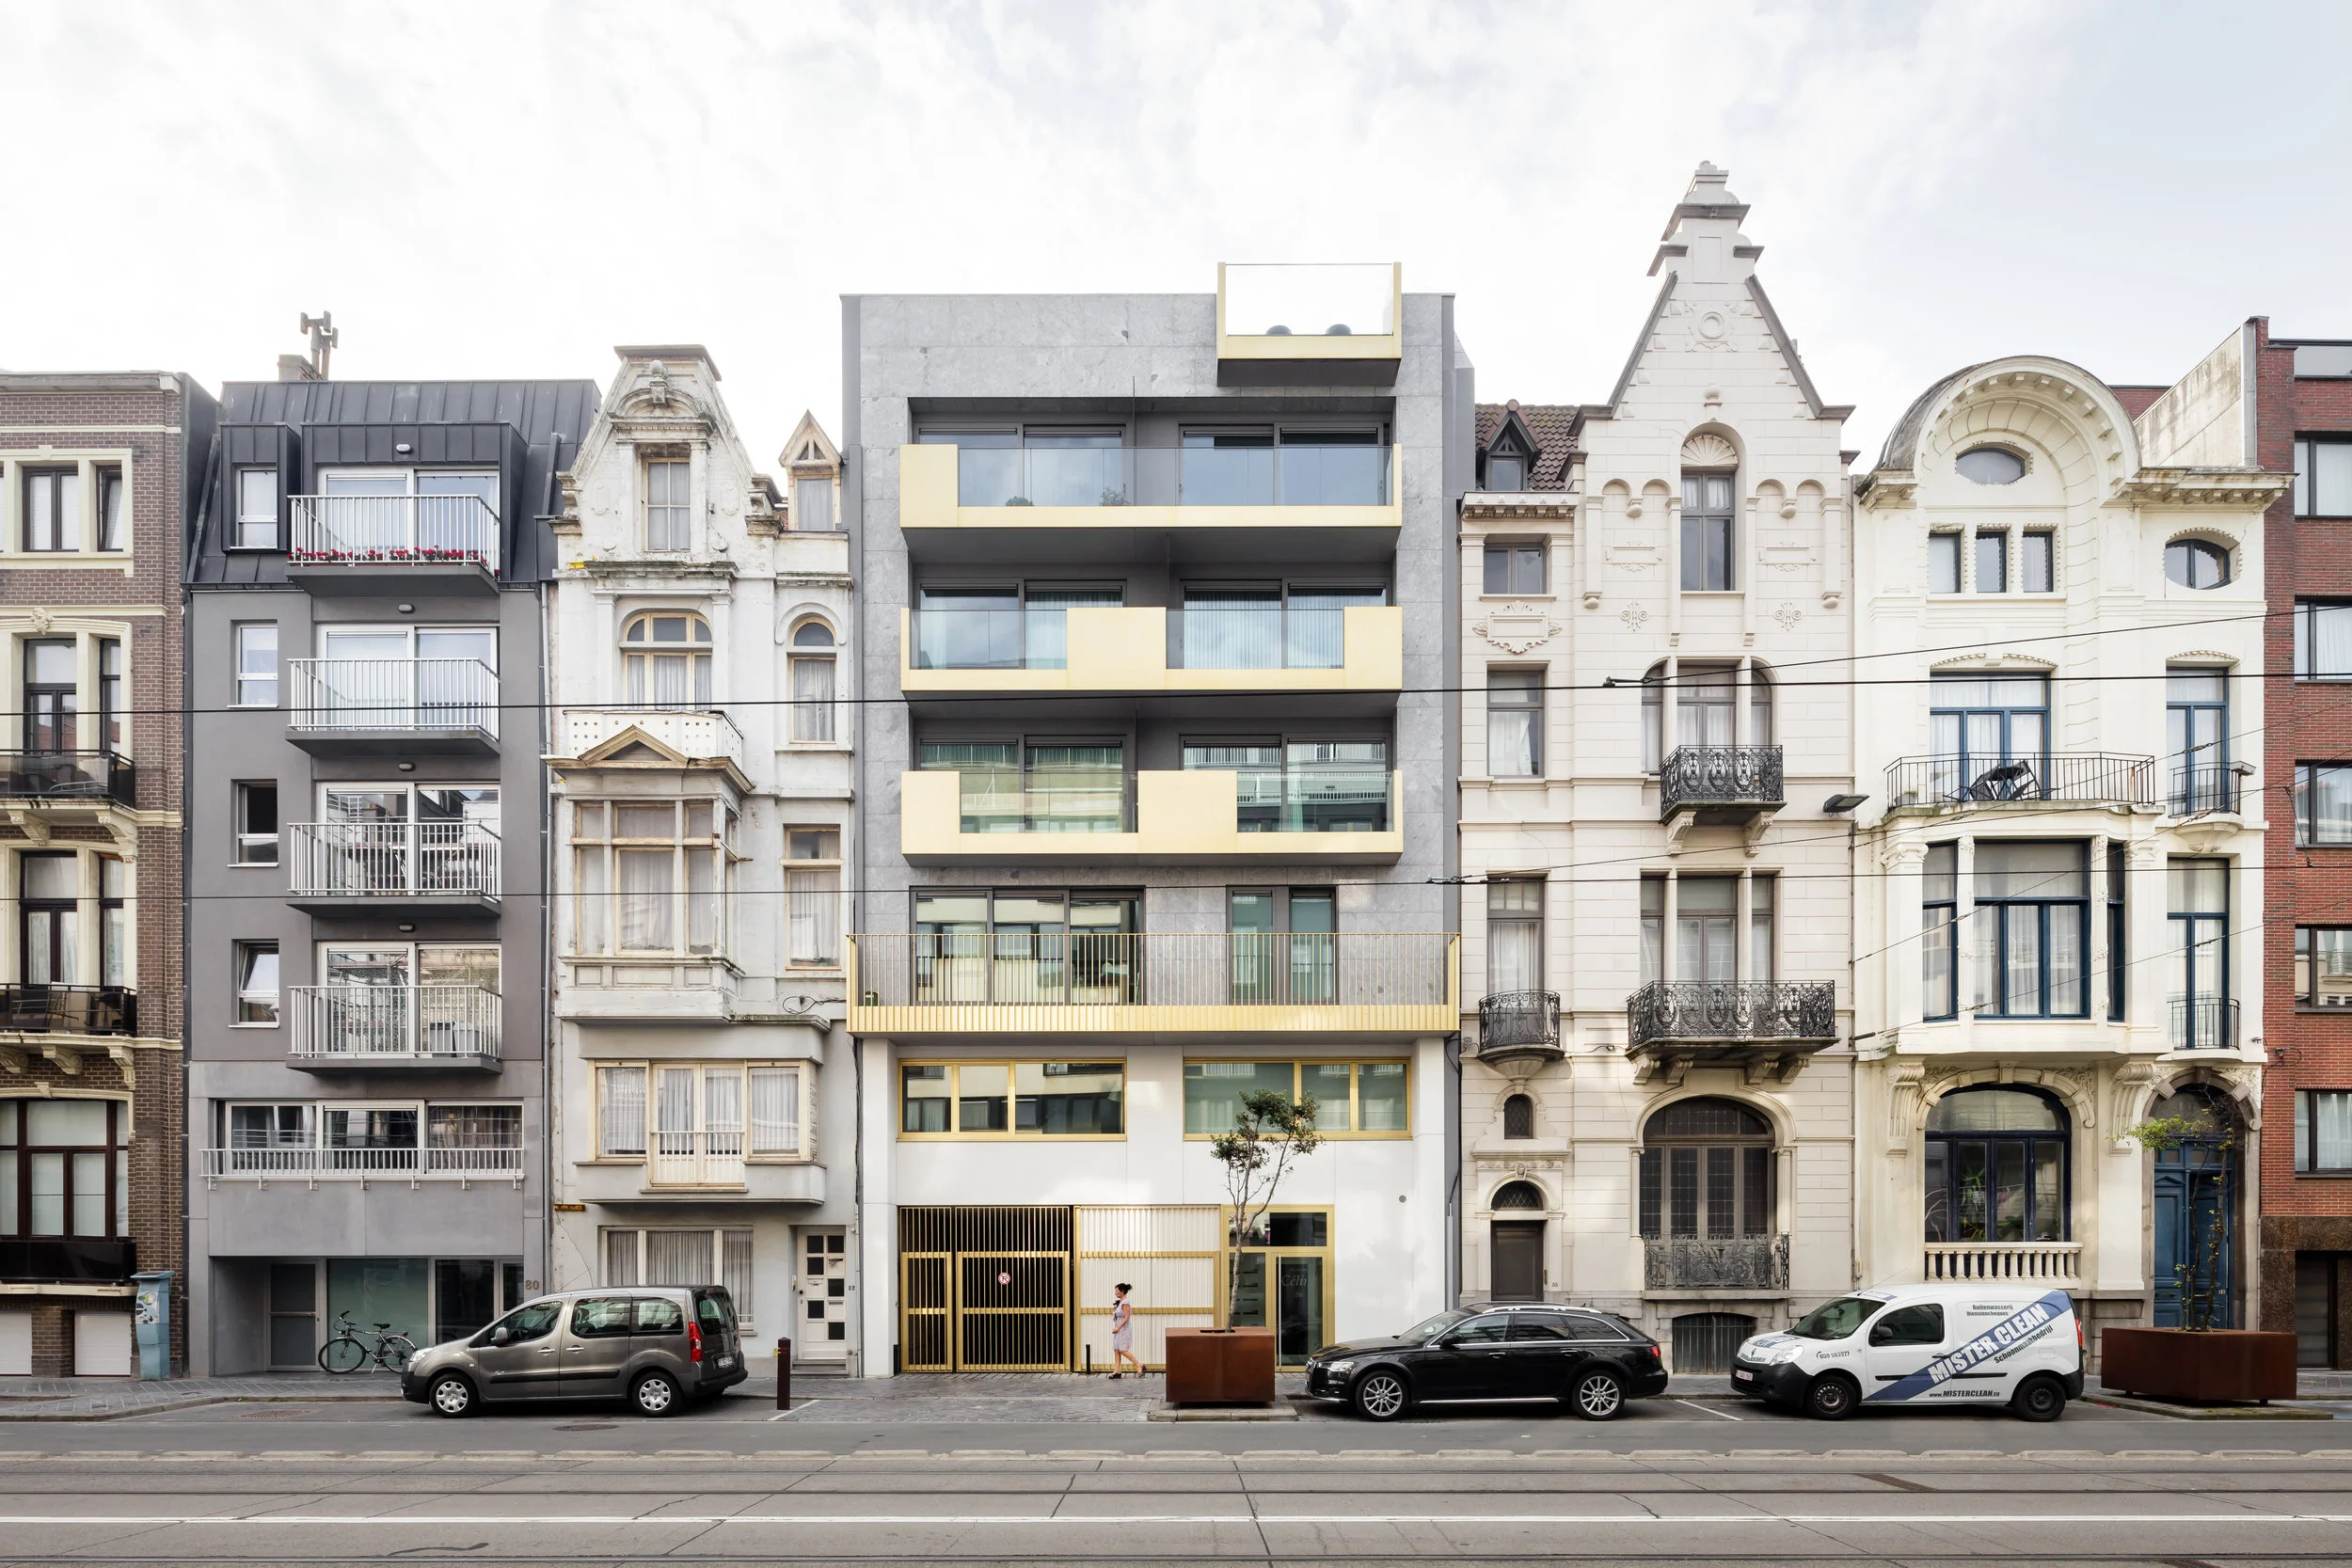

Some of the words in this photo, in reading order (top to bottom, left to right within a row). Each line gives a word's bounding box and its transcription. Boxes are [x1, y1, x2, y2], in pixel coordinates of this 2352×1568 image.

[525, 1279, 540, 1290] 80
[1928, 1336, 1999, 1384] MISTER
[1994, 1303, 2050, 1345] CLEAN
[1994, 1324, 2054, 1364] Schoonmaakbedrijf
